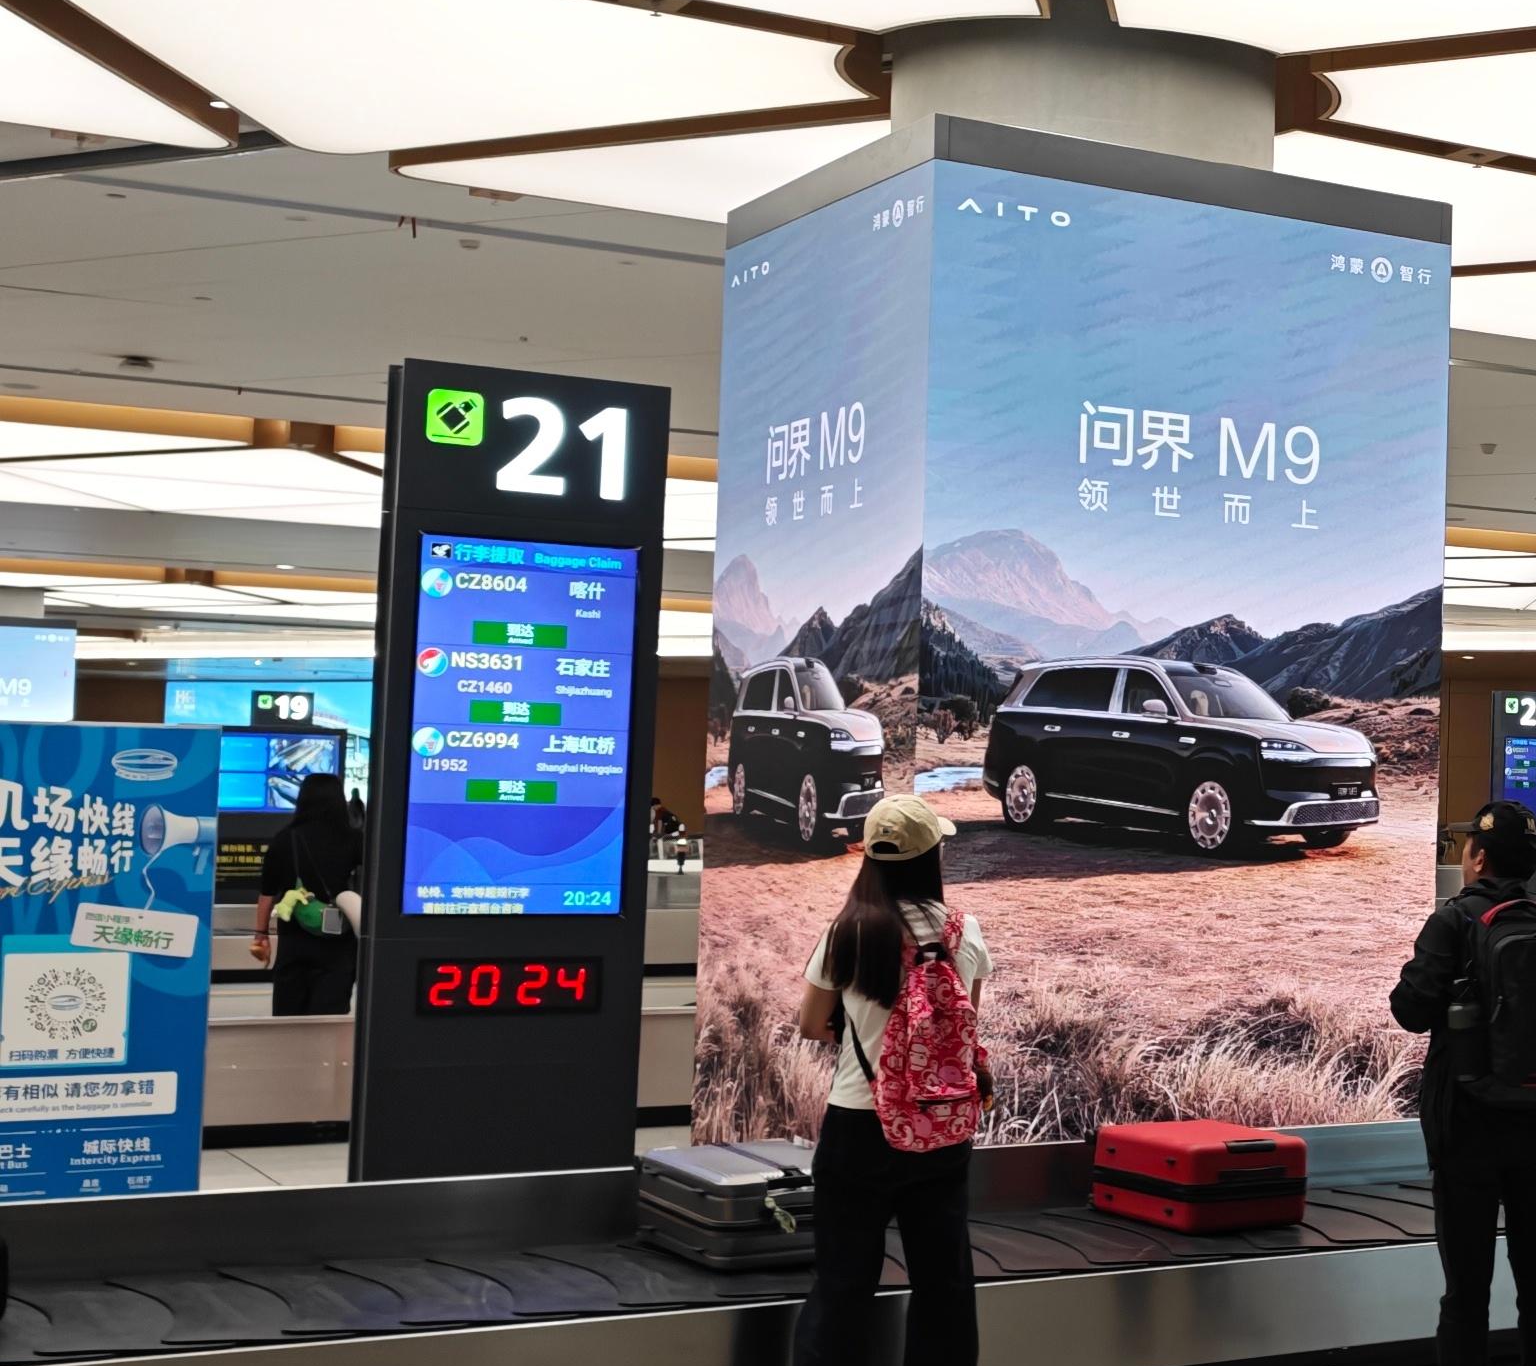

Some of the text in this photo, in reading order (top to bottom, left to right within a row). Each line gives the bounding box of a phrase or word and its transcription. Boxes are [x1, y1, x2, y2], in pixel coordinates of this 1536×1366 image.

[957, 198, 1071, 227] AITO
[731, 261, 770, 288] AITO
[1331, 254, 1432, 285] 鸿蒙 智行
[496, 396, 627, 501] 21
[766, 401, 865, 484] 问界 M9
[1078, 400, 1320, 485] 问界 M9
[765, 478, 863, 526] 领世而上
[1078, 478, 1320, 530] 领世而上
[454, 543, 622, 570] 行李提取 Baggage Claim
[455, 573, 527, 592] CZ8604
[569, 581, 605, 600] 喀什
[575, 609, 601, 619] Kashi
[506, 623, 534, 638] 到达
[451, 652, 523, 670] NS3631
[555, 658, 611, 678] 石家庄
[457, 680, 513, 695] CZ1460
[555, 685, 613, 698] Shijiazhuang
[274, 695, 309, 720] 19
[502, 702, 530, 716] 到达
[446, 731, 519, 749] CZ6994
[542, 735, 616, 755] 上海虹桥
[536, 763, 623, 776] Shanghai Hongqiao
[498, 780, 526, 794] 到达
[562, 891, 612, 906] 20:24
[92, 924, 175, 950] 天缘畅行
[428, 964, 587, 1006] 20 24
[9, 1047, 116, 1062] 扫码购票 方便快捷
[0, 1079, 155, 1101] 有相似 请您勿拿错
[15, 1104, 49, 1115] carefully
[76, 1102, 111, 1112] baggage
[83, 1137, 151, 1154] 城际快线
[7, 1160, 29, 1169] Bus
[70, 1153, 162, 1166] Intercity Express
